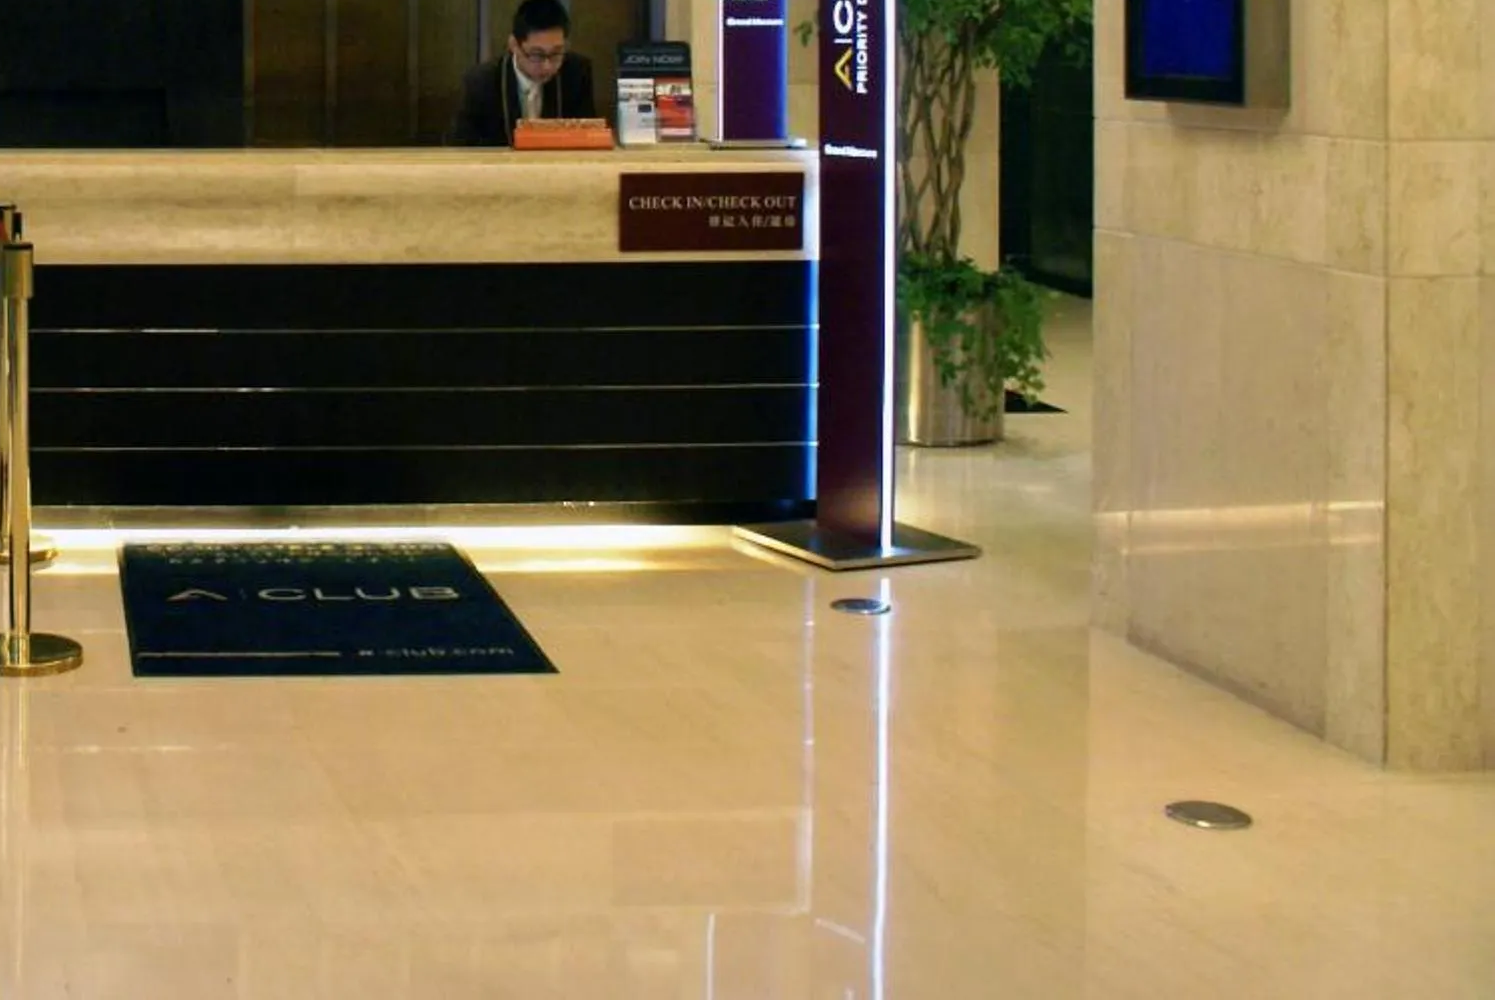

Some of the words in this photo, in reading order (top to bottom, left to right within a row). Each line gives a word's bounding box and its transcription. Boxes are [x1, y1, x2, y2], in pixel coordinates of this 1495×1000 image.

[856, 10, 868, 94] PRIORITY
[628, 196, 683, 210] CHECK
[764, 196, 797, 210] OUT
